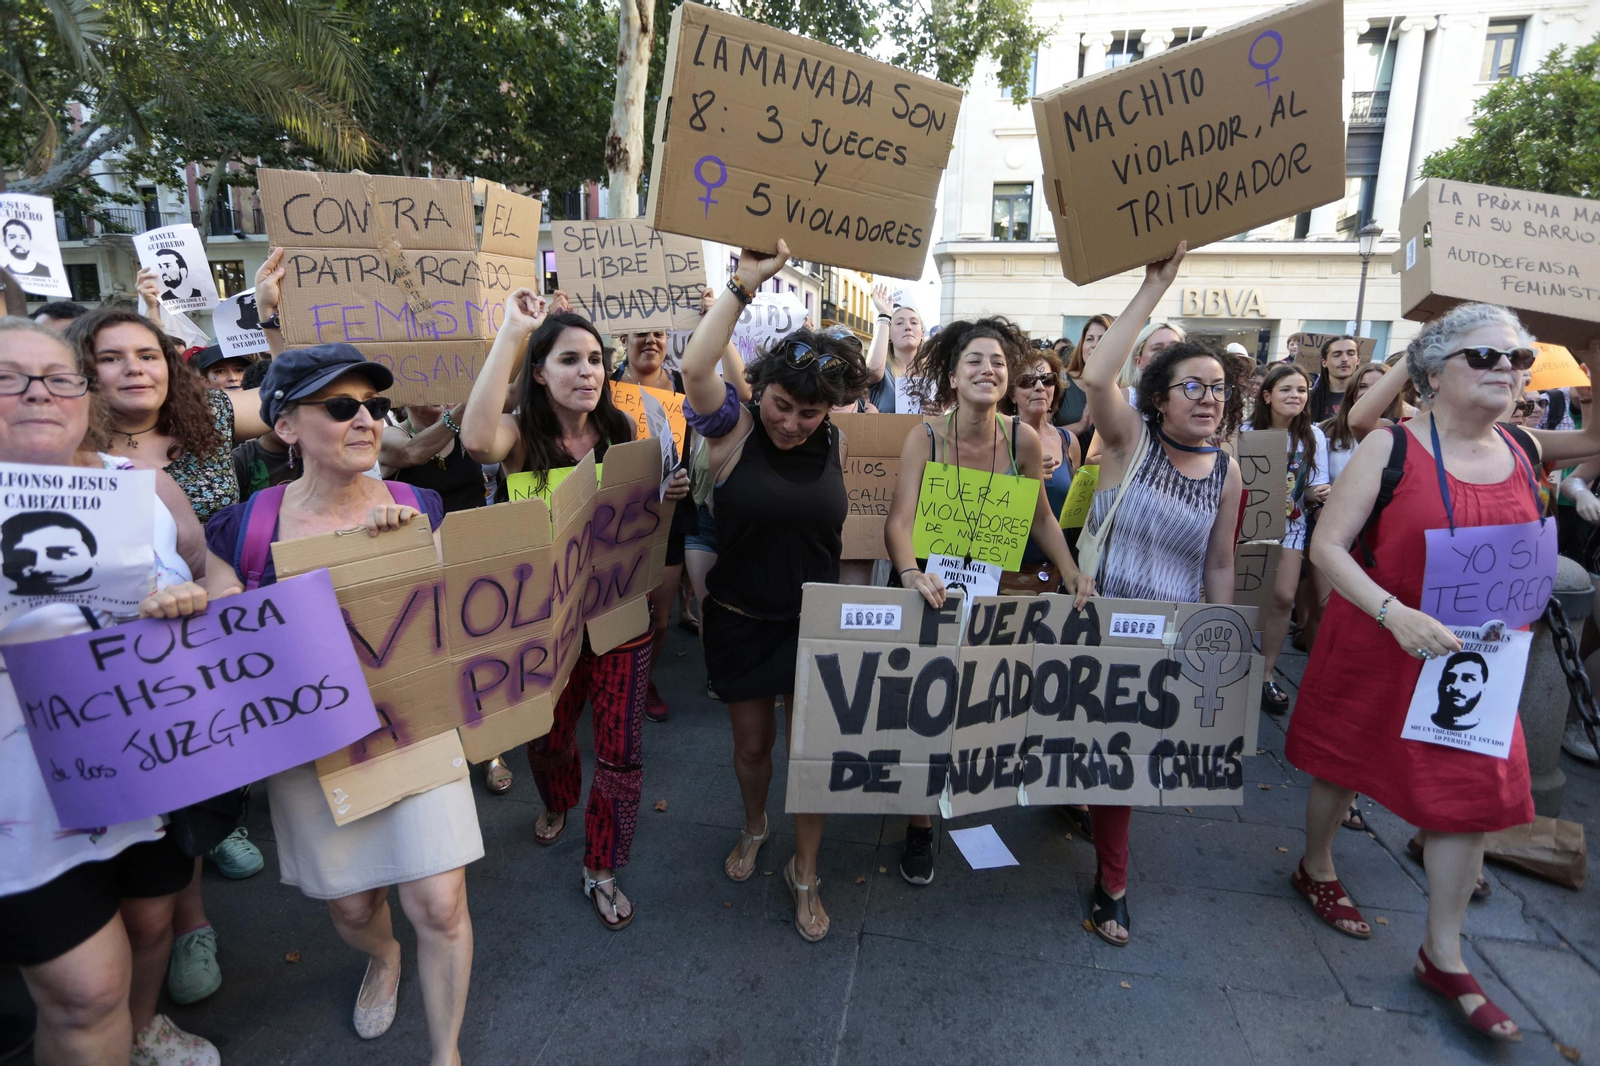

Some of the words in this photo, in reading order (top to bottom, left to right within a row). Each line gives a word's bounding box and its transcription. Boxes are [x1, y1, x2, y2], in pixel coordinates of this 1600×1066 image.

[693, 24, 728, 73] LA
[739, 43, 874, 108] MANADA
[891, 83, 946, 136] SON
[1270, 90, 1308, 129] AL
[757, 104, 784, 144] 3
[801, 119, 907, 165] JUECES
[813, 159, 828, 187] Y
[746, 182, 772, 217] 5
[1438, 183, 1462, 206] LA
[283, 193, 452, 236] CONRA
[492, 203, 520, 239] EL
[1455, 212, 1480, 227] EN
[1490, 217, 1512, 233] SU
[147, 240, 185, 251] GUERRERO
[149, 231, 177, 242] MANUEL
[563, 224, 664, 252] SEVILLA
[288, 254, 512, 290] PATRIRCADO
[579, 252, 647, 279] LIBRE
[665, 252, 699, 273] DE
[1447, 246, 1580, 279] AUTODEFENSA
[575, 282, 707, 323] VIOLADORES
[1181, 288, 1267, 317] BBVA
[226, 334, 239, 342] SOY
[239, 333, 250, 341] UN
[250, 331, 266, 339] VIOL
[232, 339, 257, 349] ESTADO
[68, 475, 118, 491] JESUS
[848, 487, 894, 502] CALL
[928, 477, 1010, 508] FUERA
[4, 493, 102, 511] CABEZUELO
[920, 501, 1029, 538] VIOLADORES
[925, 523, 943, 534] DE
[957, 529, 1019, 549] NUESTRAS
[939, 558, 960, 569] JOSE
[1452, 543, 1496, 573] YO
[341, 500, 660, 668] VIOLADORES
[944, 571, 977, 585] PRENDA
[102, 597, 140, 606] ESTADO
[1428, 582, 1480, 615] TE
[1486, 576, 1552, 612] CREO
[88, 598, 286, 671] FUERA
[918, 597, 1102, 647] FUERA
[1452, 630, 1480, 640] ALFONS
[1460, 642, 1499, 653] ABEZUELO
[122, 675, 350, 772] JUZGADOS
[1432, 728, 1462, 738] VIOLADOR
[1478, 736, 1504, 747] ESTADO
[1443, 735, 1471, 747] PERMITE
[828, 749, 902, 793] DE
[925, 731, 1135, 797] NUESTRAS
[1148, 736, 1244, 791] CALLES
